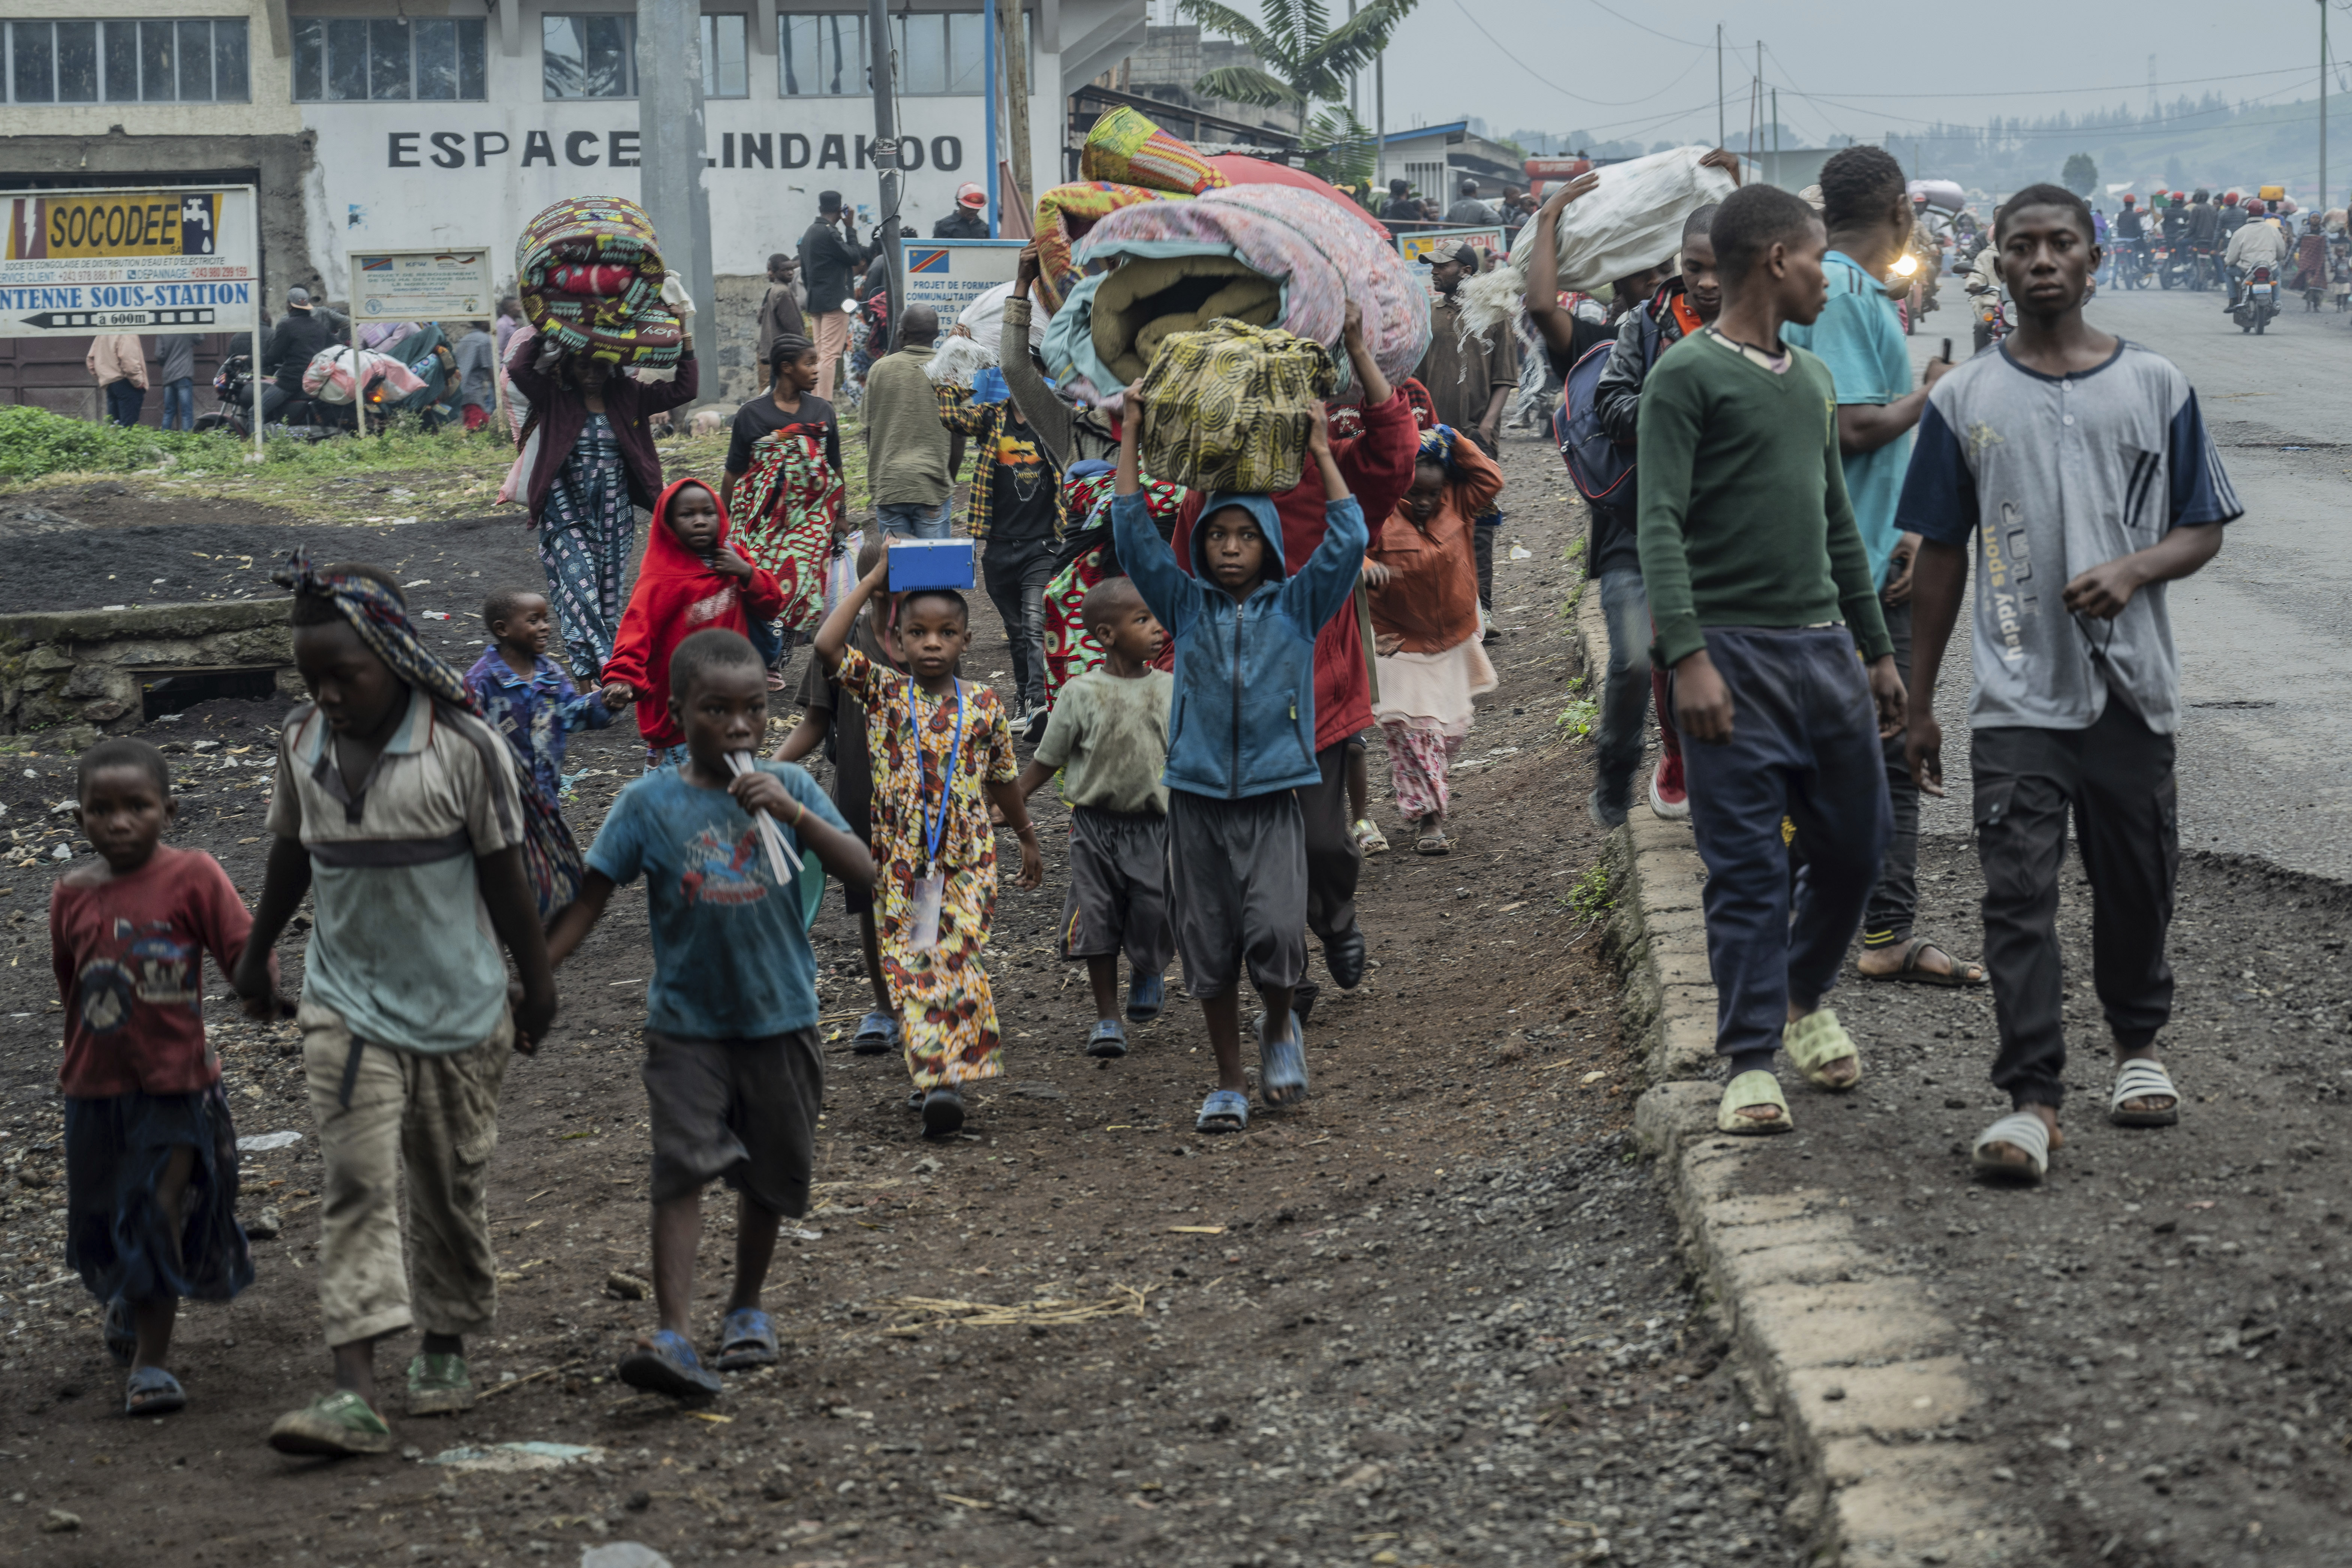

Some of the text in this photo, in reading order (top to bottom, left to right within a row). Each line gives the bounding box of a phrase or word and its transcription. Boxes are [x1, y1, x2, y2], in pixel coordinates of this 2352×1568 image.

[388, 131, 962, 171] ESPACE INDAKOO
[50, 204, 179, 247] SOCODEE
[36, 260, 79, 269] CONGOLAISE
[81, 260, 91, 268] DE
[91, 258, 140, 268] DISTRIBUTION
[191, 267, 207, 277] +243
[913, 281, 945, 289] PROJET
[91, 283, 249, 308] SOUS-STATION
[111, 312, 146, 325] 600m
[1982, 524, 2024, 662] happy sport
